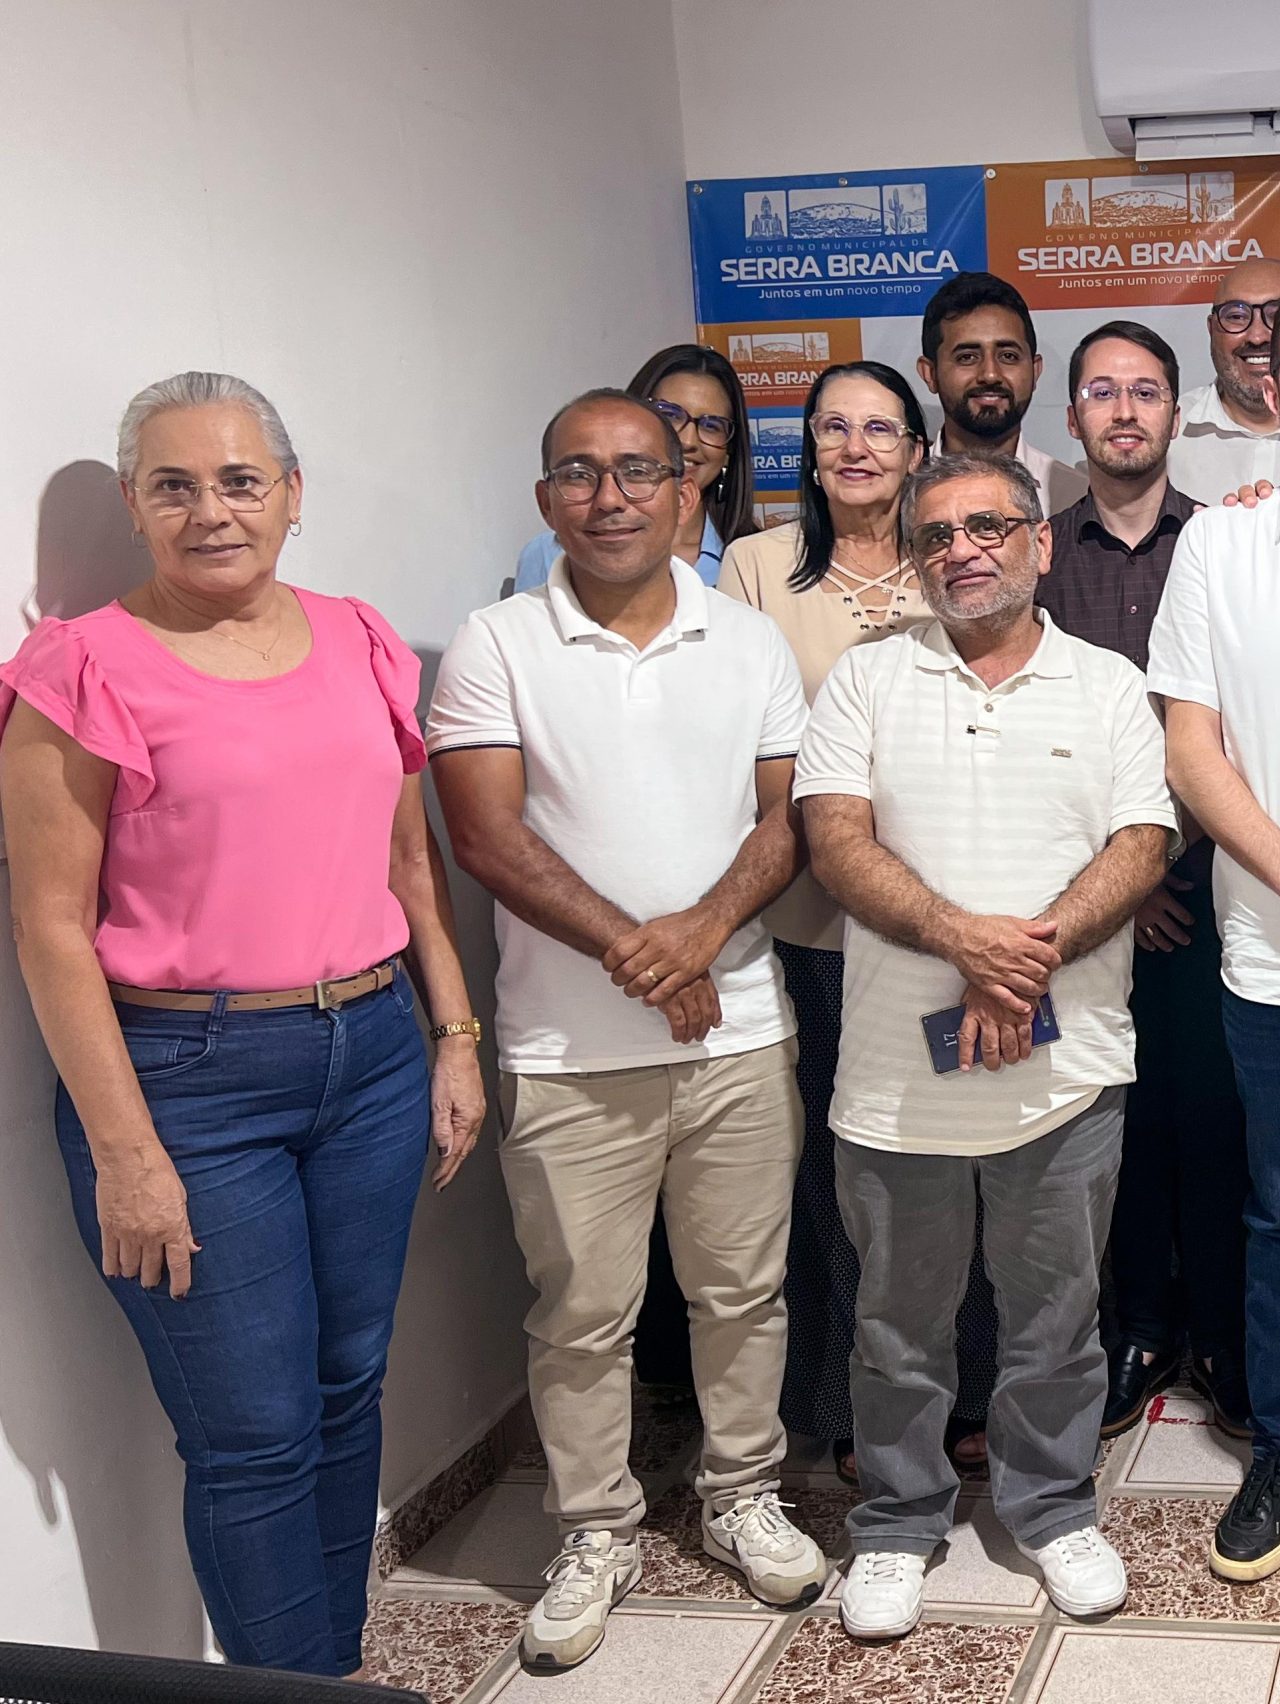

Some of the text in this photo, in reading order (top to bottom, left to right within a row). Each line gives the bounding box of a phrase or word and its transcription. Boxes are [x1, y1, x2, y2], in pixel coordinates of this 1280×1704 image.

[1045, 231, 1119, 242] GOVERNO
[745, 238, 929, 254] GOVERNO MUNICIPAL DE
[1017, 238, 1264, 271] SERRA BRANCA
[720, 249, 960, 282] SERRA BRANCA
[1058, 278, 1102, 289] Juntos
[1105, 278, 1124, 287] em
[1127, 276, 1147, 286] um
[1150, 275, 1182, 285] novo
[758, 284, 921, 299] Juntos em um novo tempo
[736, 370, 823, 386] RRA BRAN
